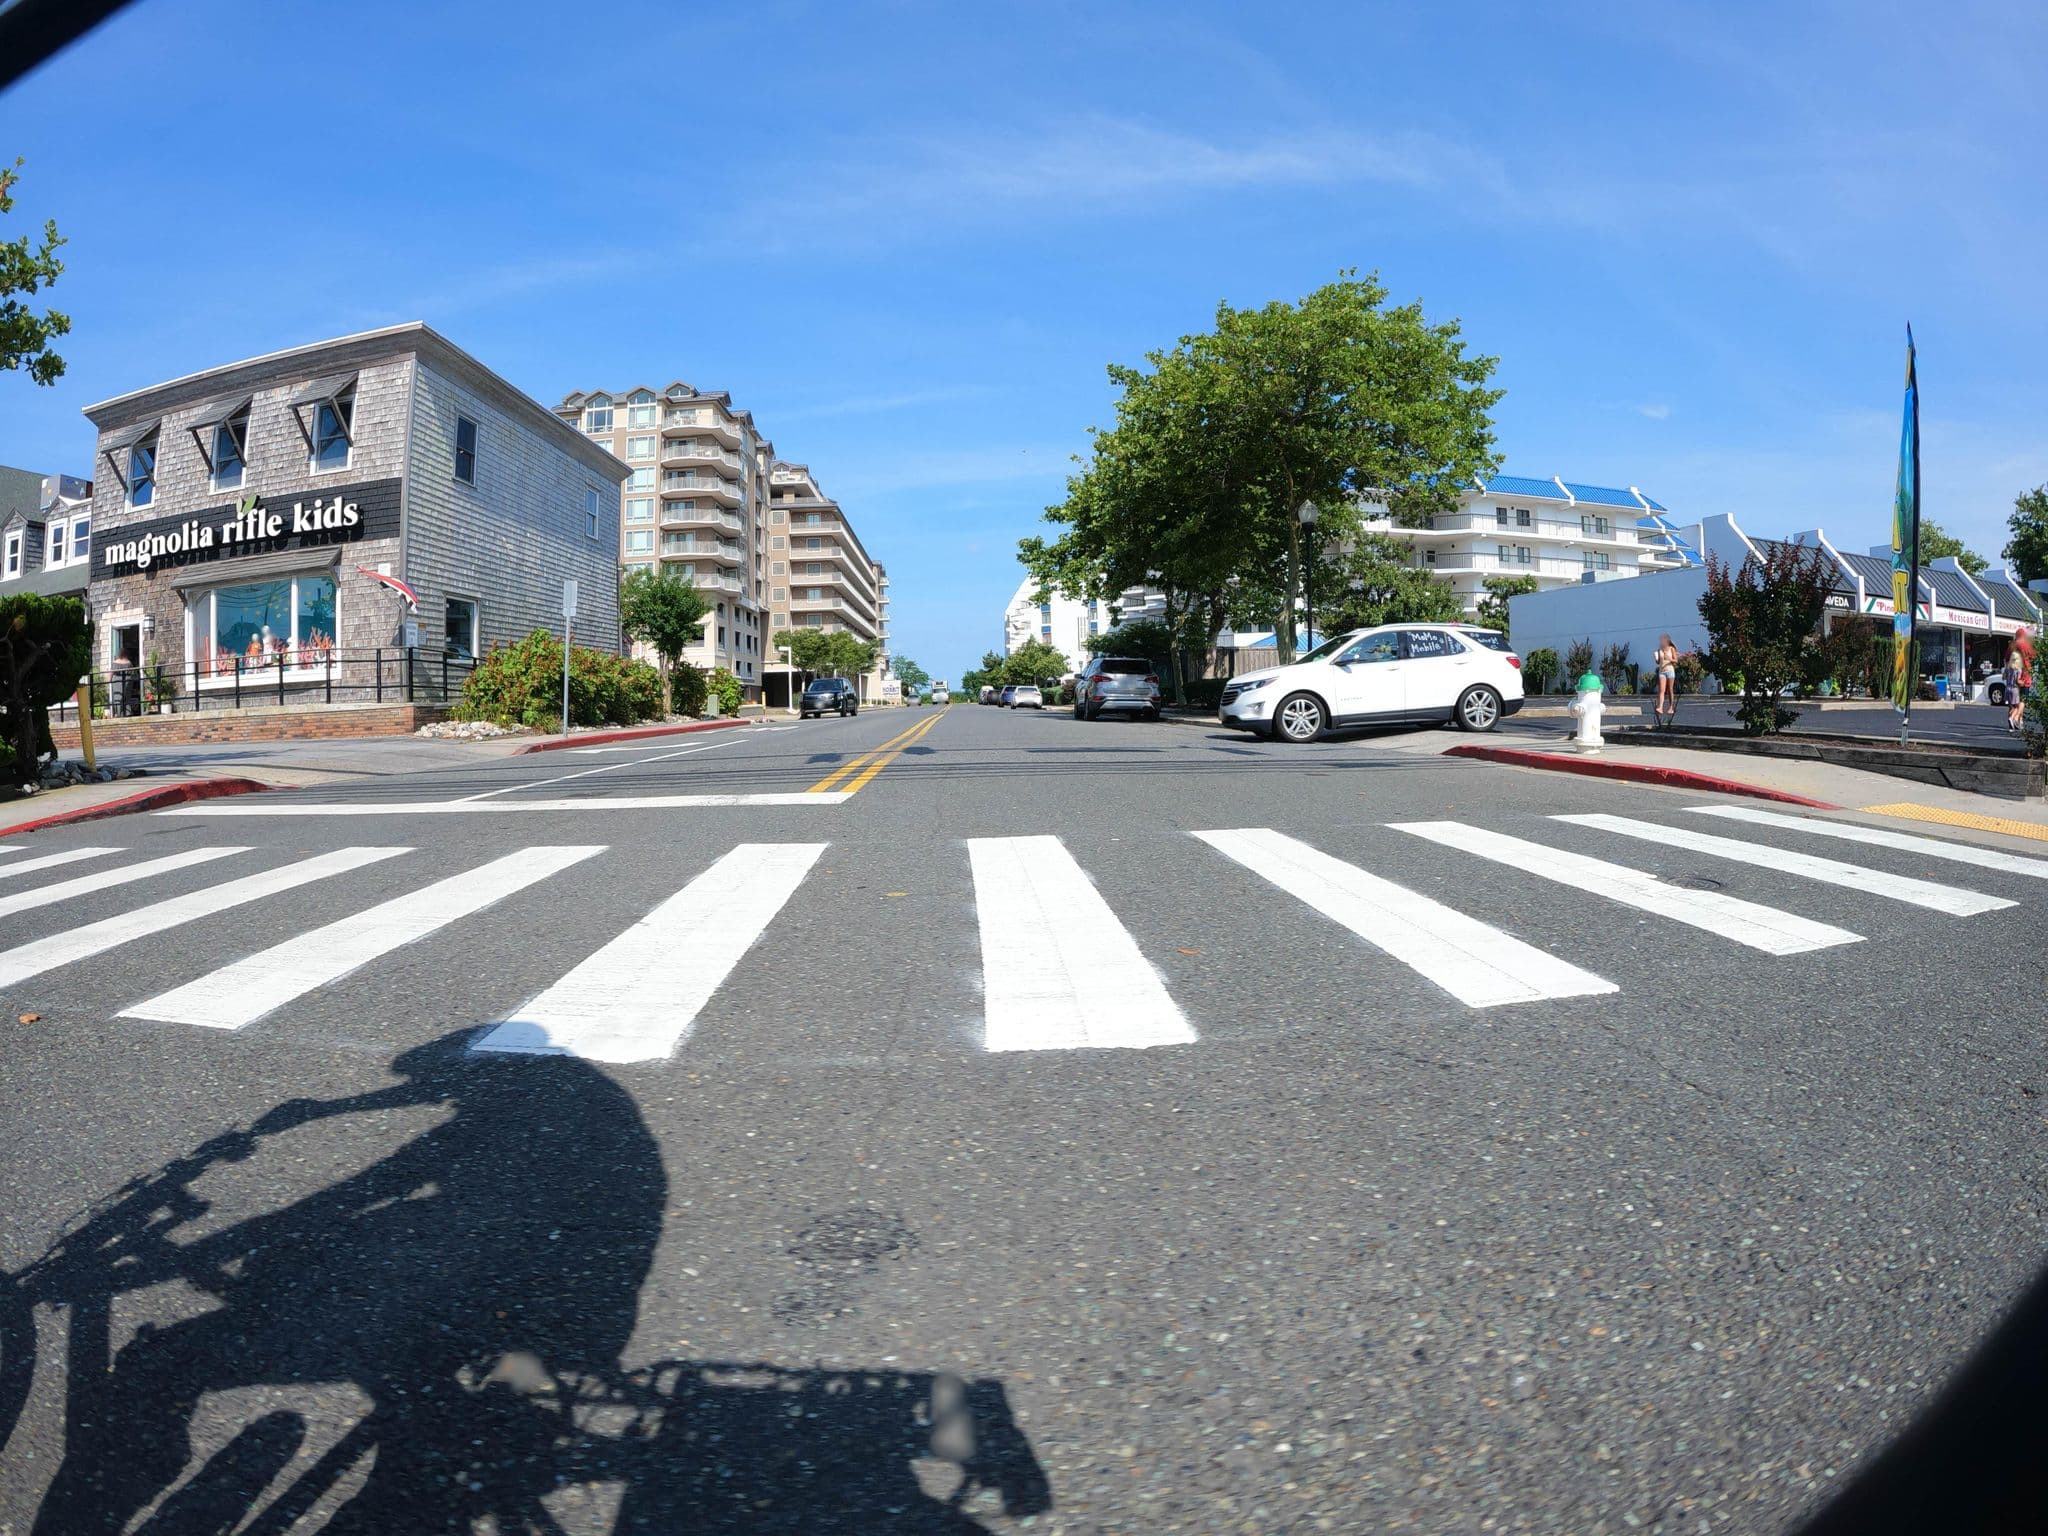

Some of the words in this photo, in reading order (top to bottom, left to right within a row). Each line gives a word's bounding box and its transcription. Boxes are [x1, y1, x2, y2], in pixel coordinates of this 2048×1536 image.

[104, 520, 214, 568] magnolia
[222, 507, 283, 544] rifle
[292, 496, 360, 534] kids
[1825, 595, 1850, 608] AVEDA
[1948, 611, 1974, 625] Mexican
[1974, 615, 1988, 627] Grill
